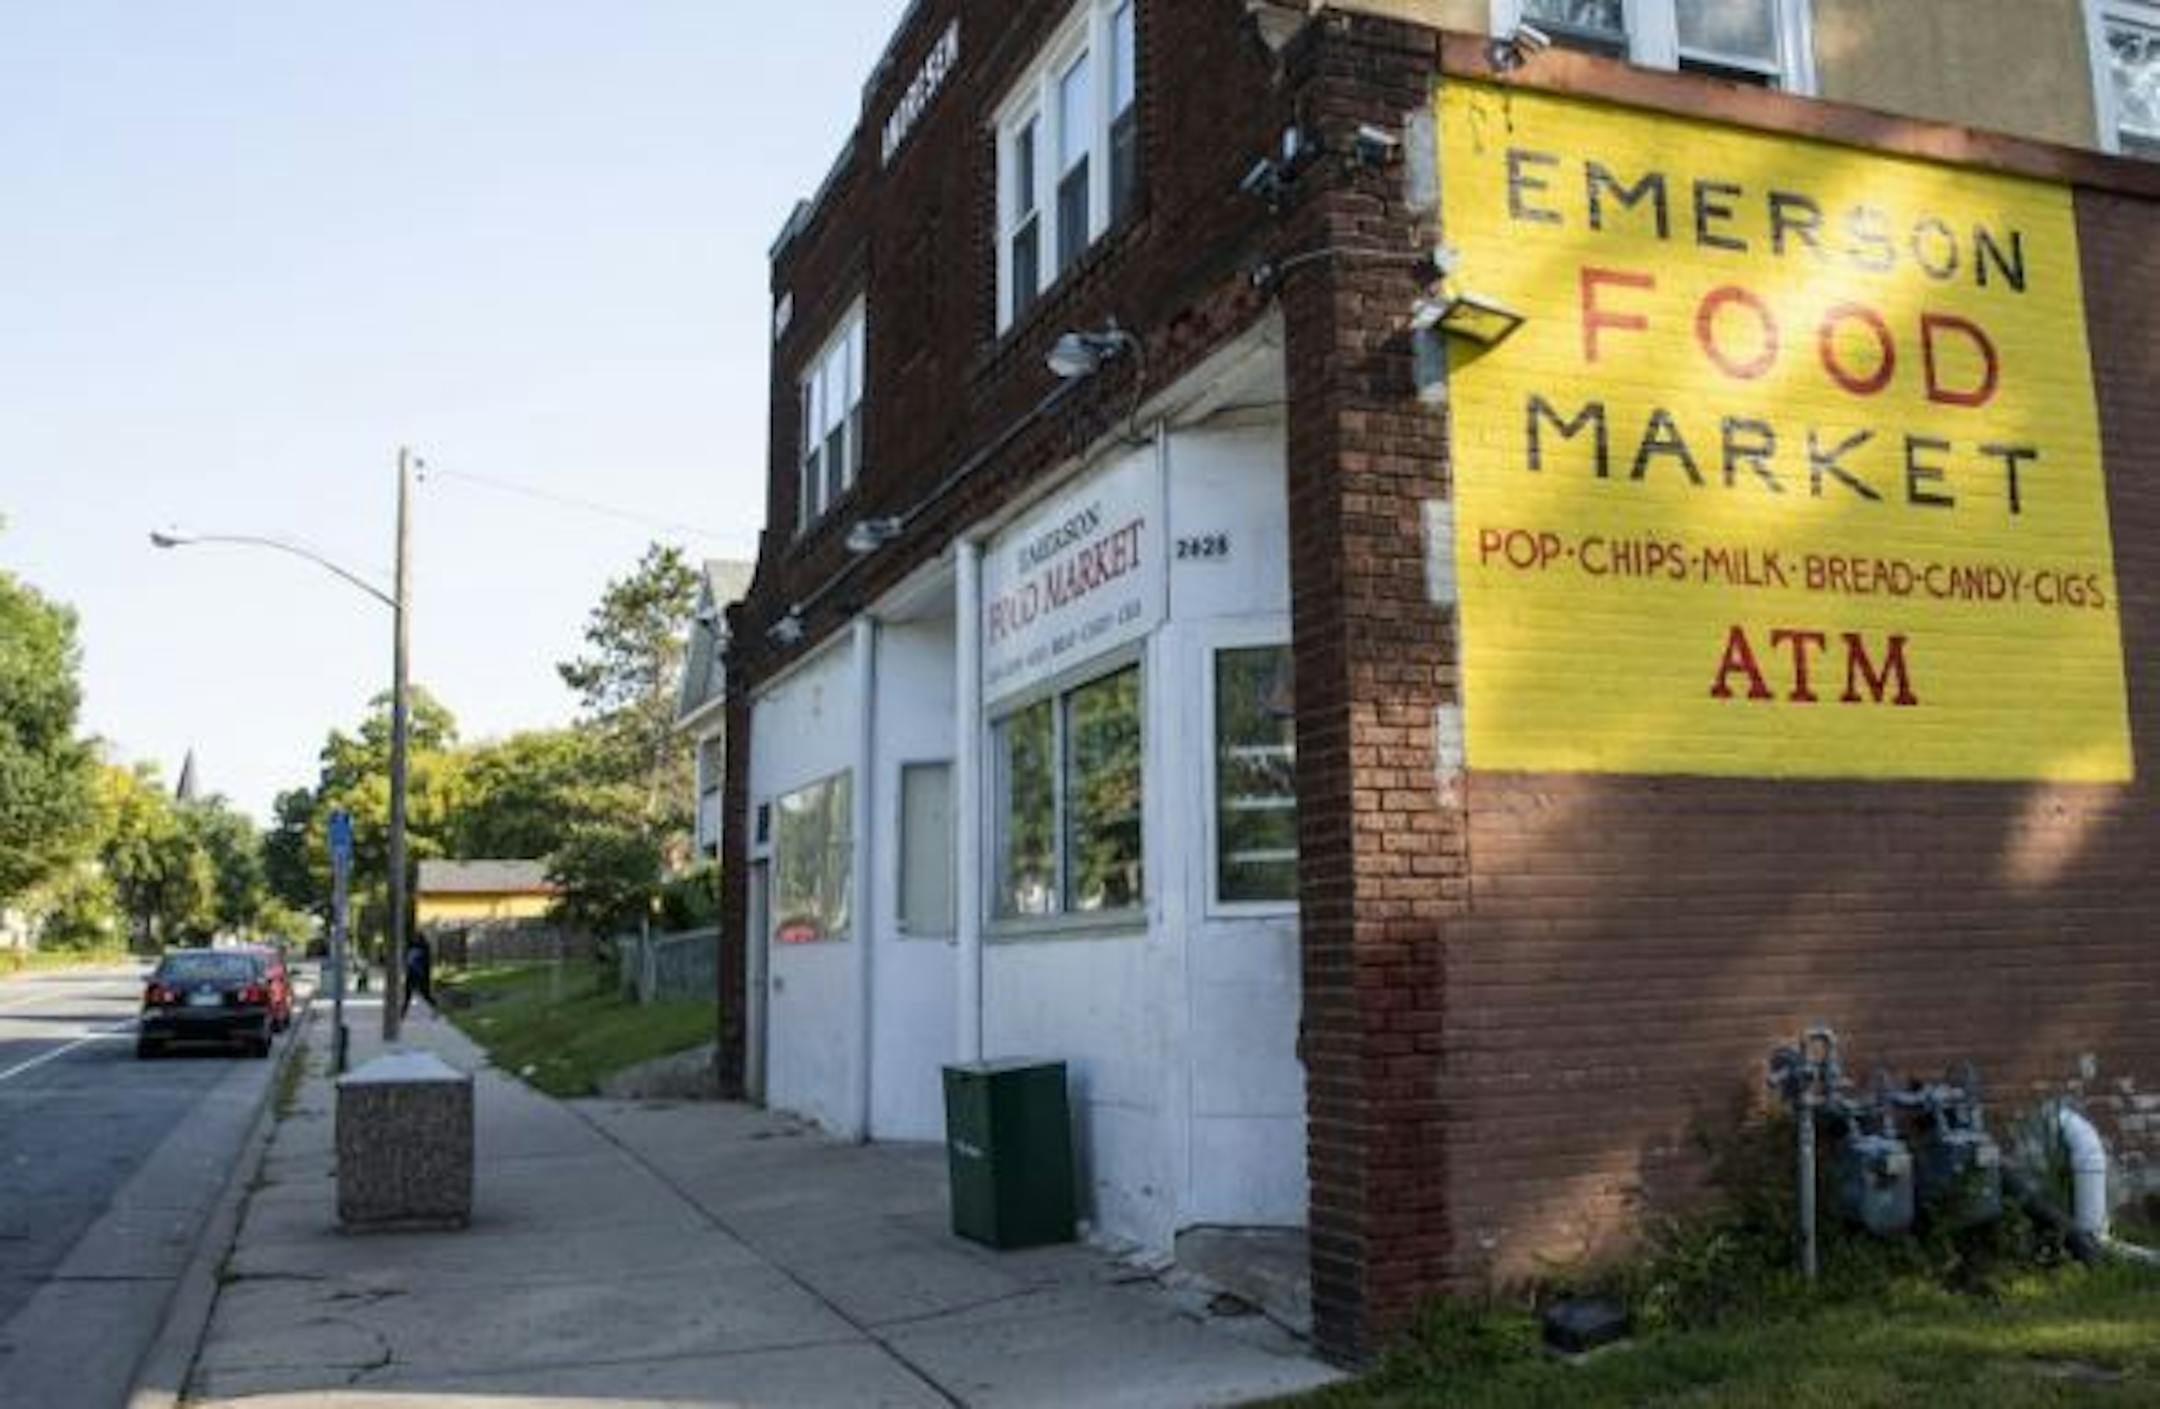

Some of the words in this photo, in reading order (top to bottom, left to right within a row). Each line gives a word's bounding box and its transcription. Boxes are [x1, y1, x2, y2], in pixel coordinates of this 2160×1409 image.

[1506, 148, 2026, 294] EMERSON
[1578, 267, 1999, 408] FOOD
[1526, 394, 2038, 515] MARKET
[1043, 515, 1145, 615] MARKET
[1709, 624, 1918, 706] ATM
